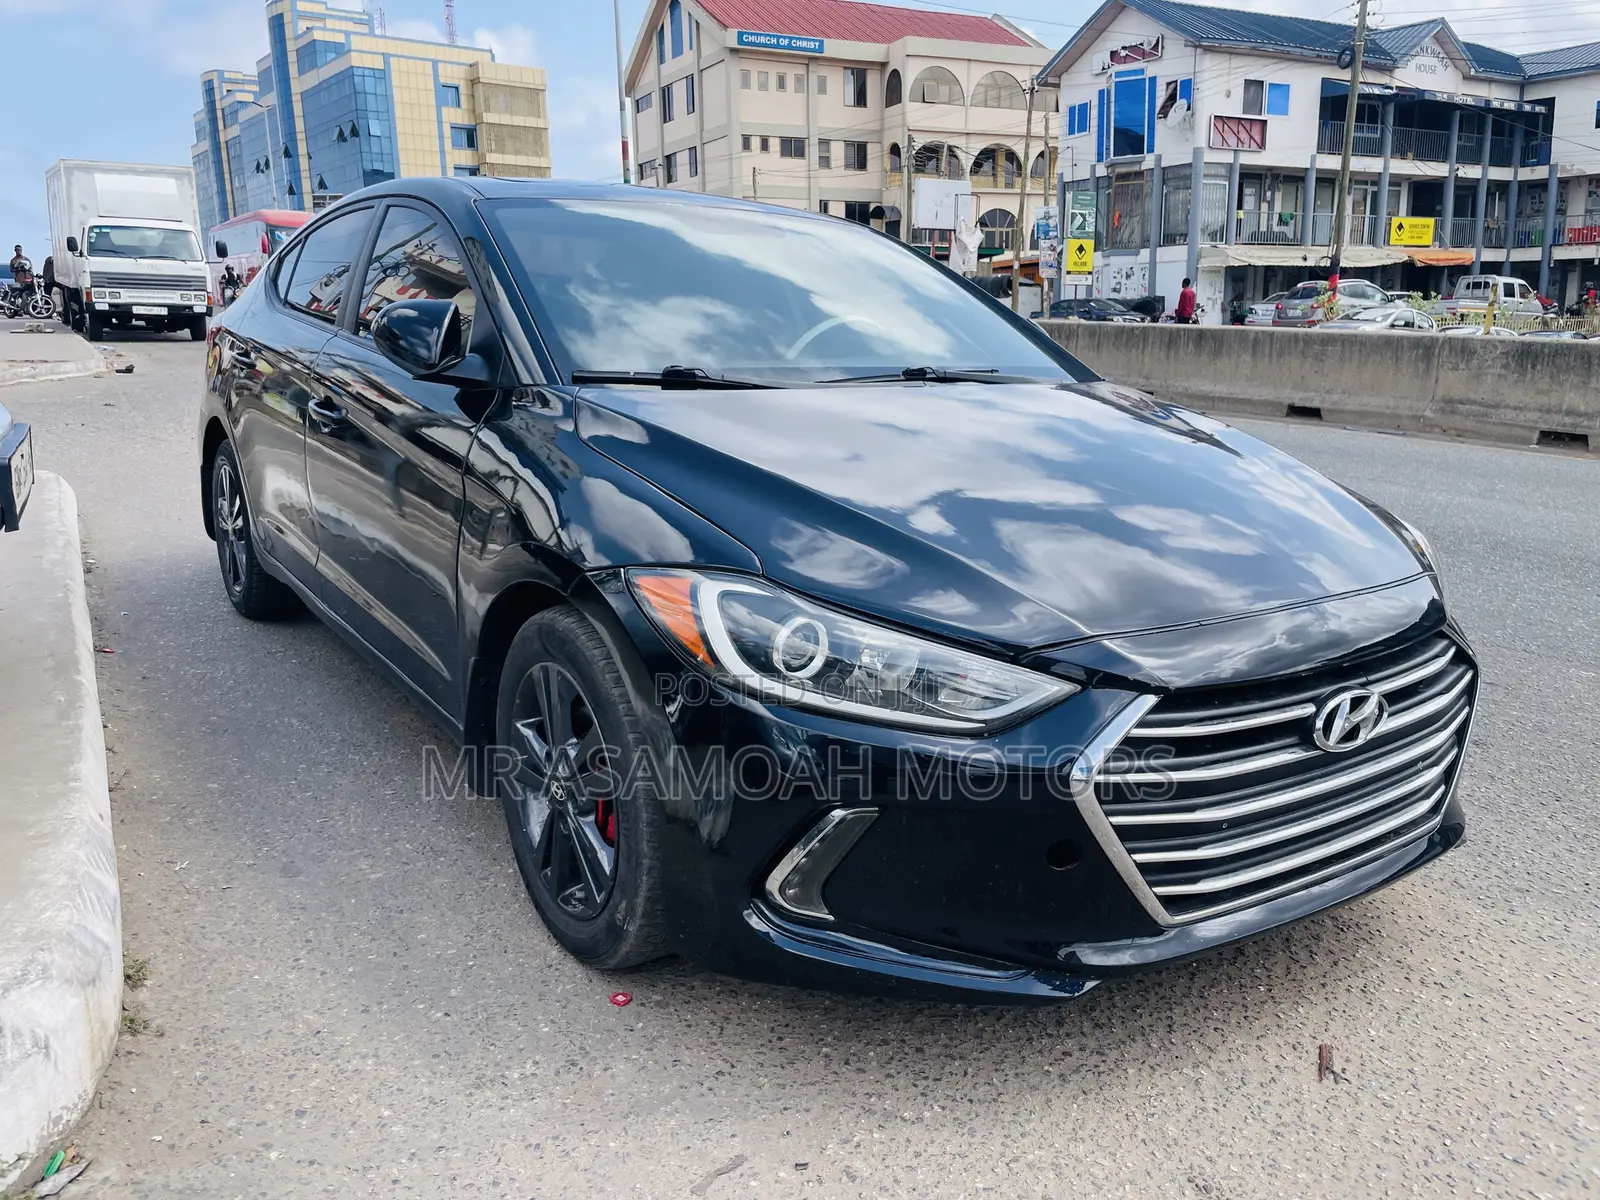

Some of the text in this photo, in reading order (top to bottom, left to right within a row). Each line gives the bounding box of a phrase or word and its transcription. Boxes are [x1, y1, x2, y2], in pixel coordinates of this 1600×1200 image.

[742, 34, 820, 50] CHURCH OF CHRIST
[1415, 62, 1438, 75] HOUSE
[1453, 95, 1476, 106] HOTEL
